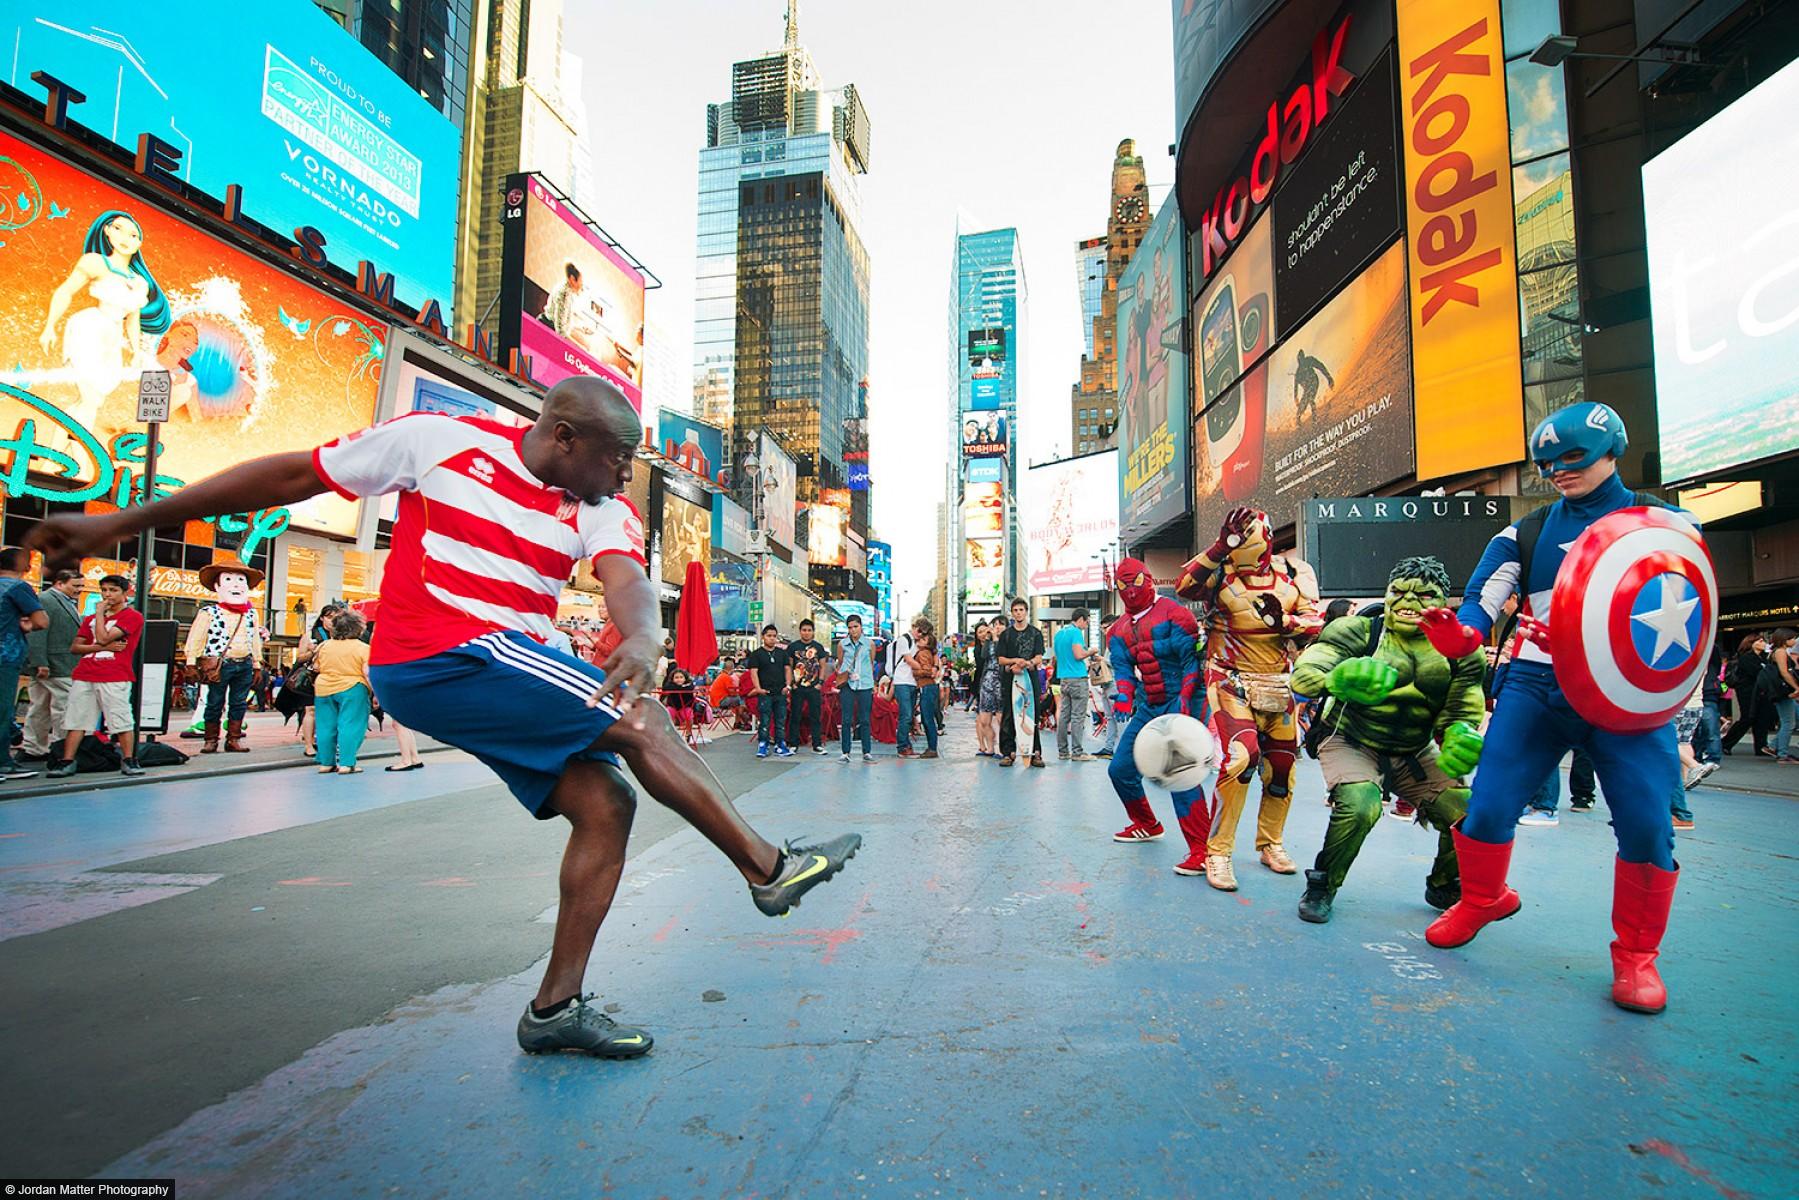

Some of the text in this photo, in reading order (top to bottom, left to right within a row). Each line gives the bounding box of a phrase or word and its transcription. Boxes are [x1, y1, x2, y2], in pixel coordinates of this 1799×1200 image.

[310, 56, 392, 129] PROUD TO BE
[265, 98, 333, 156] PARTNER
[332, 104, 417, 177] ENERGY STAR
[1201, 14, 1357, 279] Kodak
[331, 124, 411, 191] AWARD 2013
[1331, 176, 1346, 200] be
[1348, 150, 1366, 180] left
[1409, 17, 1502, 328] Kodak
[284, 138, 401, 227] VORNADO
[507, 209, 521, 218] LG
[1288, 253, 1298, 269] to
[565, 351, 575, 365] LG
[142, 396, 166, 406] WALK
[143, 408, 163, 417] BIKE
[963, 443, 1006, 453] TOSHIBA
[1151, 419, 1168, 450] THE
[1275, 450, 1293, 472] BUILT
[1294, 444, 1309, 459] FOR
[1309, 433, 1324, 452] THE
[1325, 422, 1345, 442] WAY
[1345, 409, 1366, 430] YOU
[1367, 393, 1393, 419] PLAY.
[1538, 423, 1560, 448] A
[1124, 432, 1175, 499] MILLERS
[1318, 500, 1498, 519] MARQUIS
[1718, 612, 1740, 620] ARRIOTT
[1770, 607, 1791, 615] HOTEL
